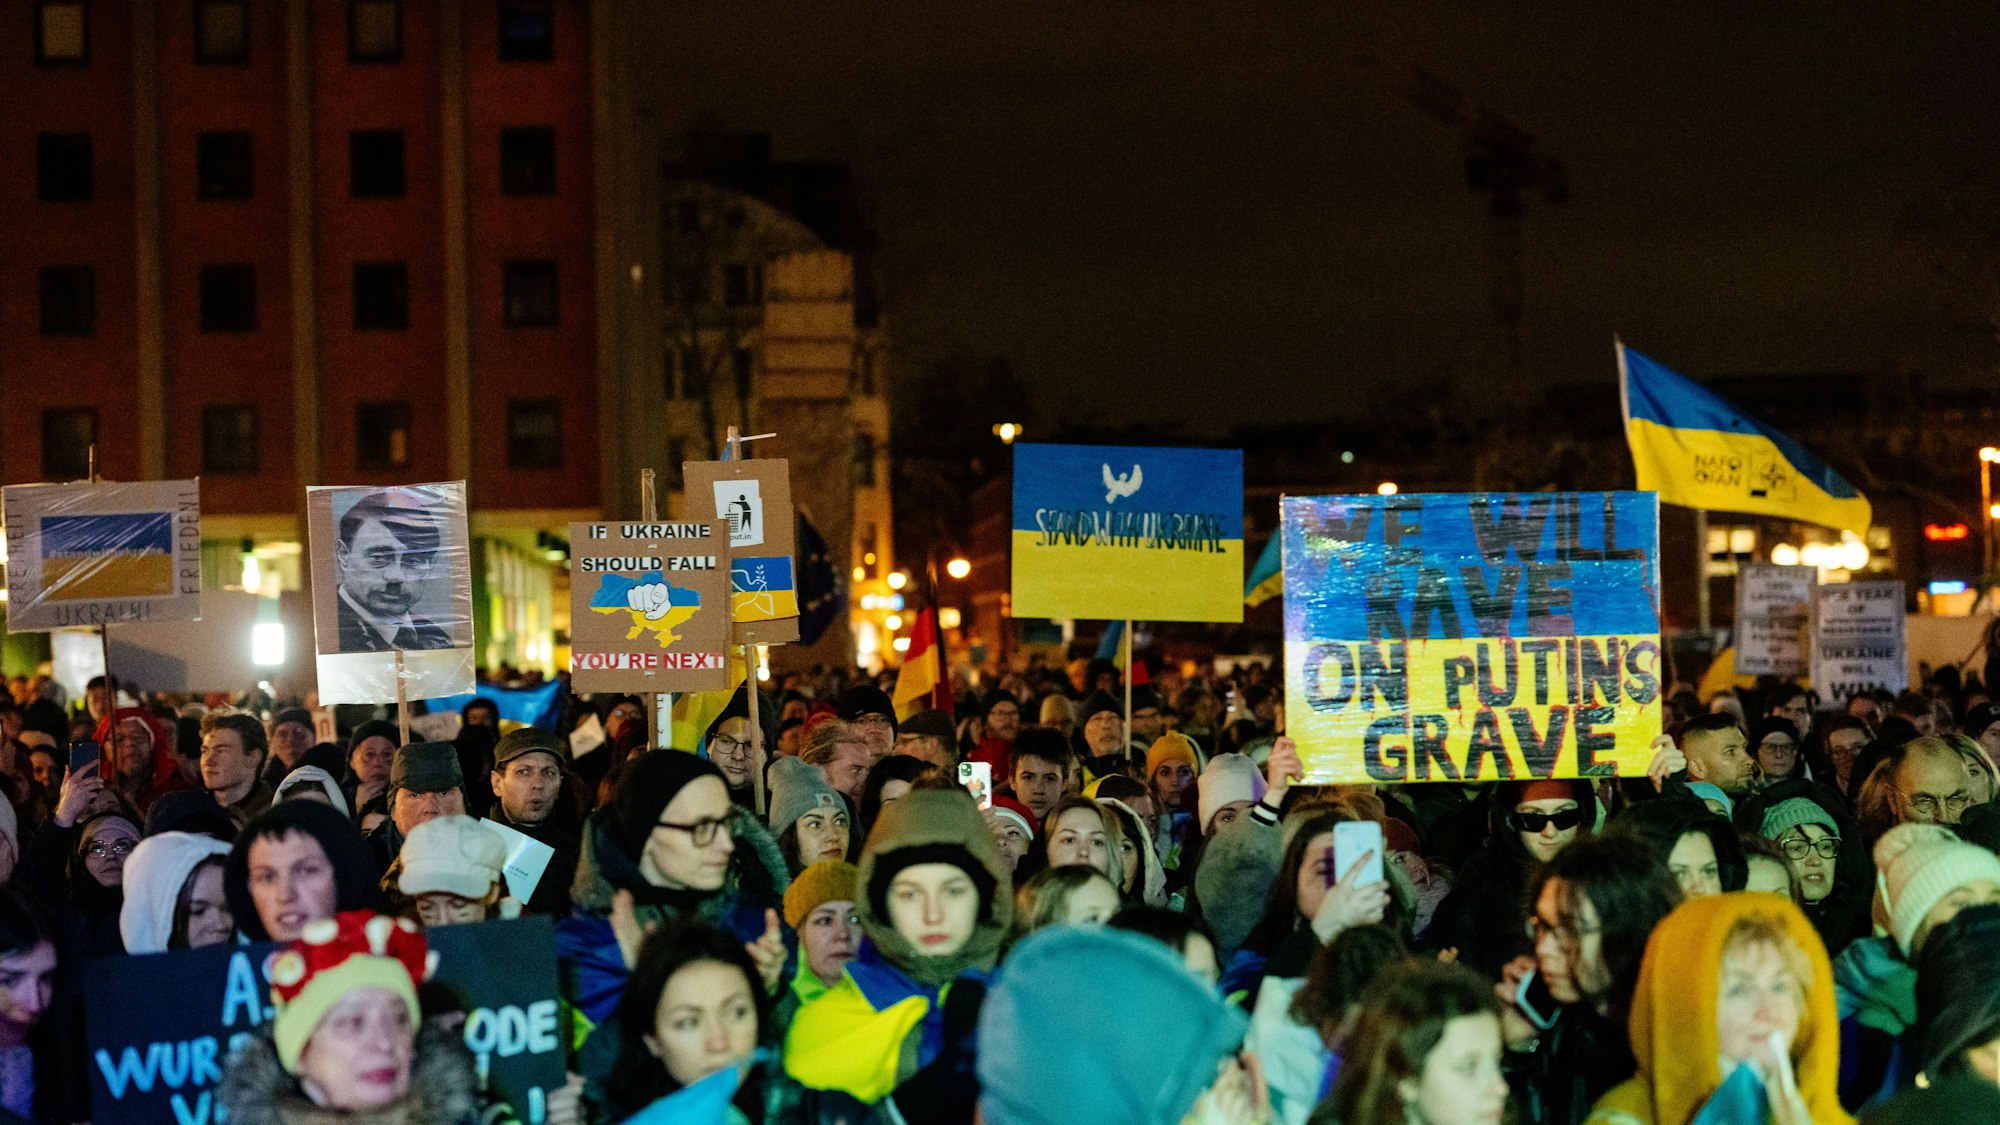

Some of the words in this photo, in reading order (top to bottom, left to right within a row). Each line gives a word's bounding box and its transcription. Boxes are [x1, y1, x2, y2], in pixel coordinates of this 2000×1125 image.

[588, 525, 607, 539] IF
[621, 523, 712, 539] UKRAINE
[1035, 507, 1092, 548] STAND
[1093, 509, 1141, 549] WITH
[1142, 511, 1227, 554] UKRAINE
[1468, 492, 1646, 566] WILL
[581, 557, 663, 572] SHOULD
[667, 555, 716, 570] FALL
[663, 652, 724, 669] NEXT
[1303, 642, 1408, 713] ON
[1444, 637, 1661, 709] PUTIN'S
[1363, 705, 1618, 782] GRAVE
